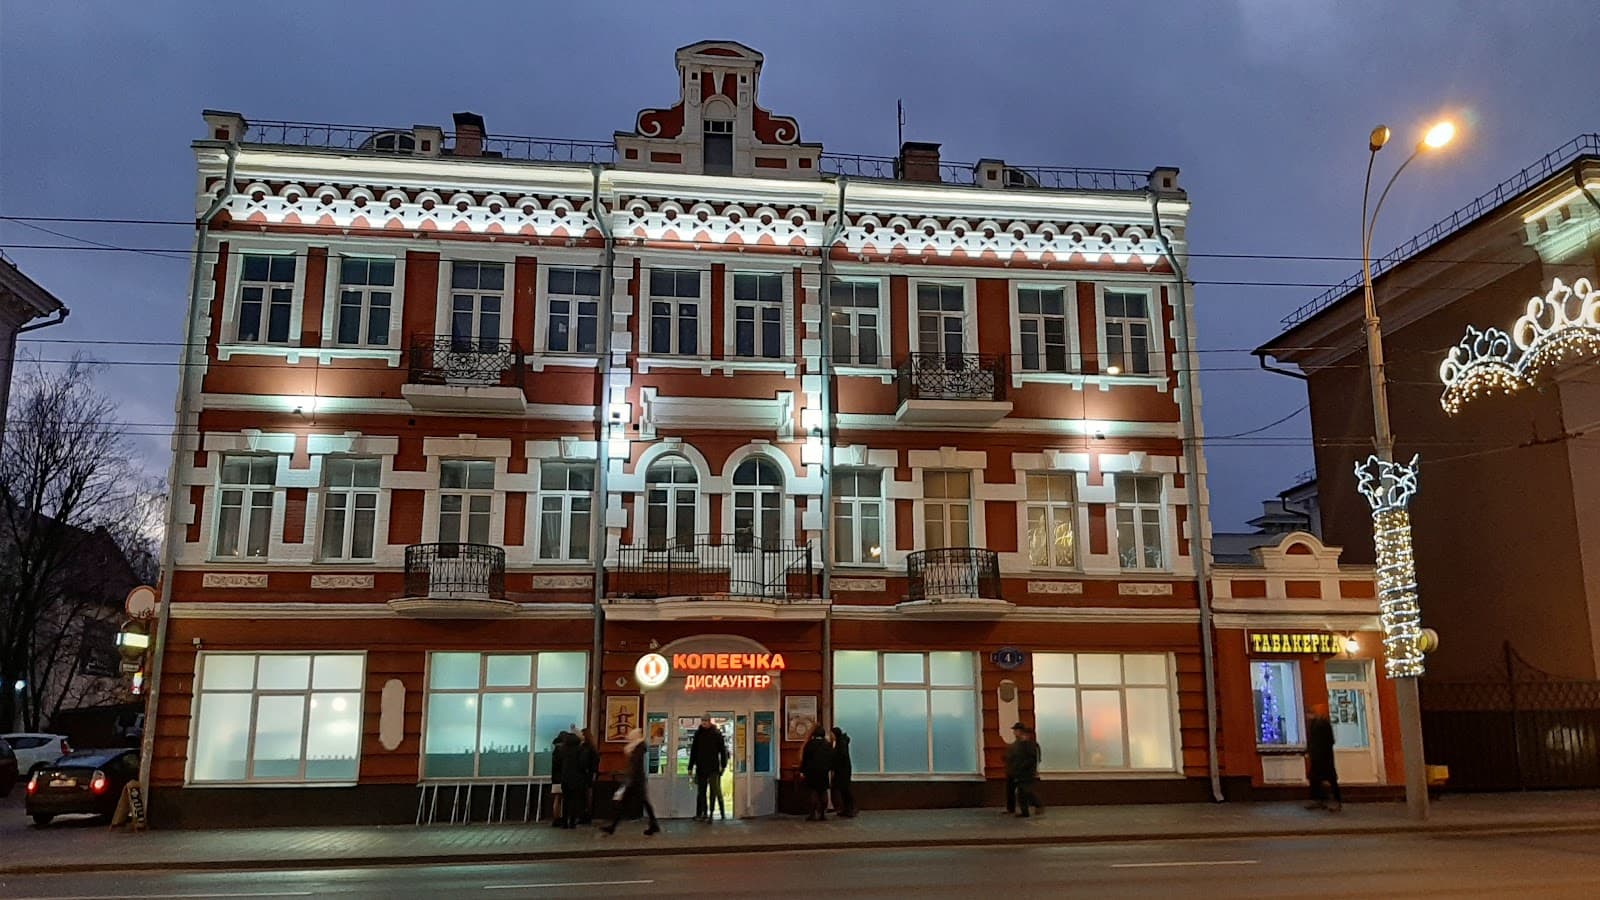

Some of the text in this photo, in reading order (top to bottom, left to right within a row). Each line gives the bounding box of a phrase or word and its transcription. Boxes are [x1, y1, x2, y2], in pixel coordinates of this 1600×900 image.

[1252, 633, 1341, 653] ТАБАКЕРКА
[673, 653, 786, 669] КОПЕЕЧКА
[684, 674, 771, 691] ДИСКАУНТЕР
